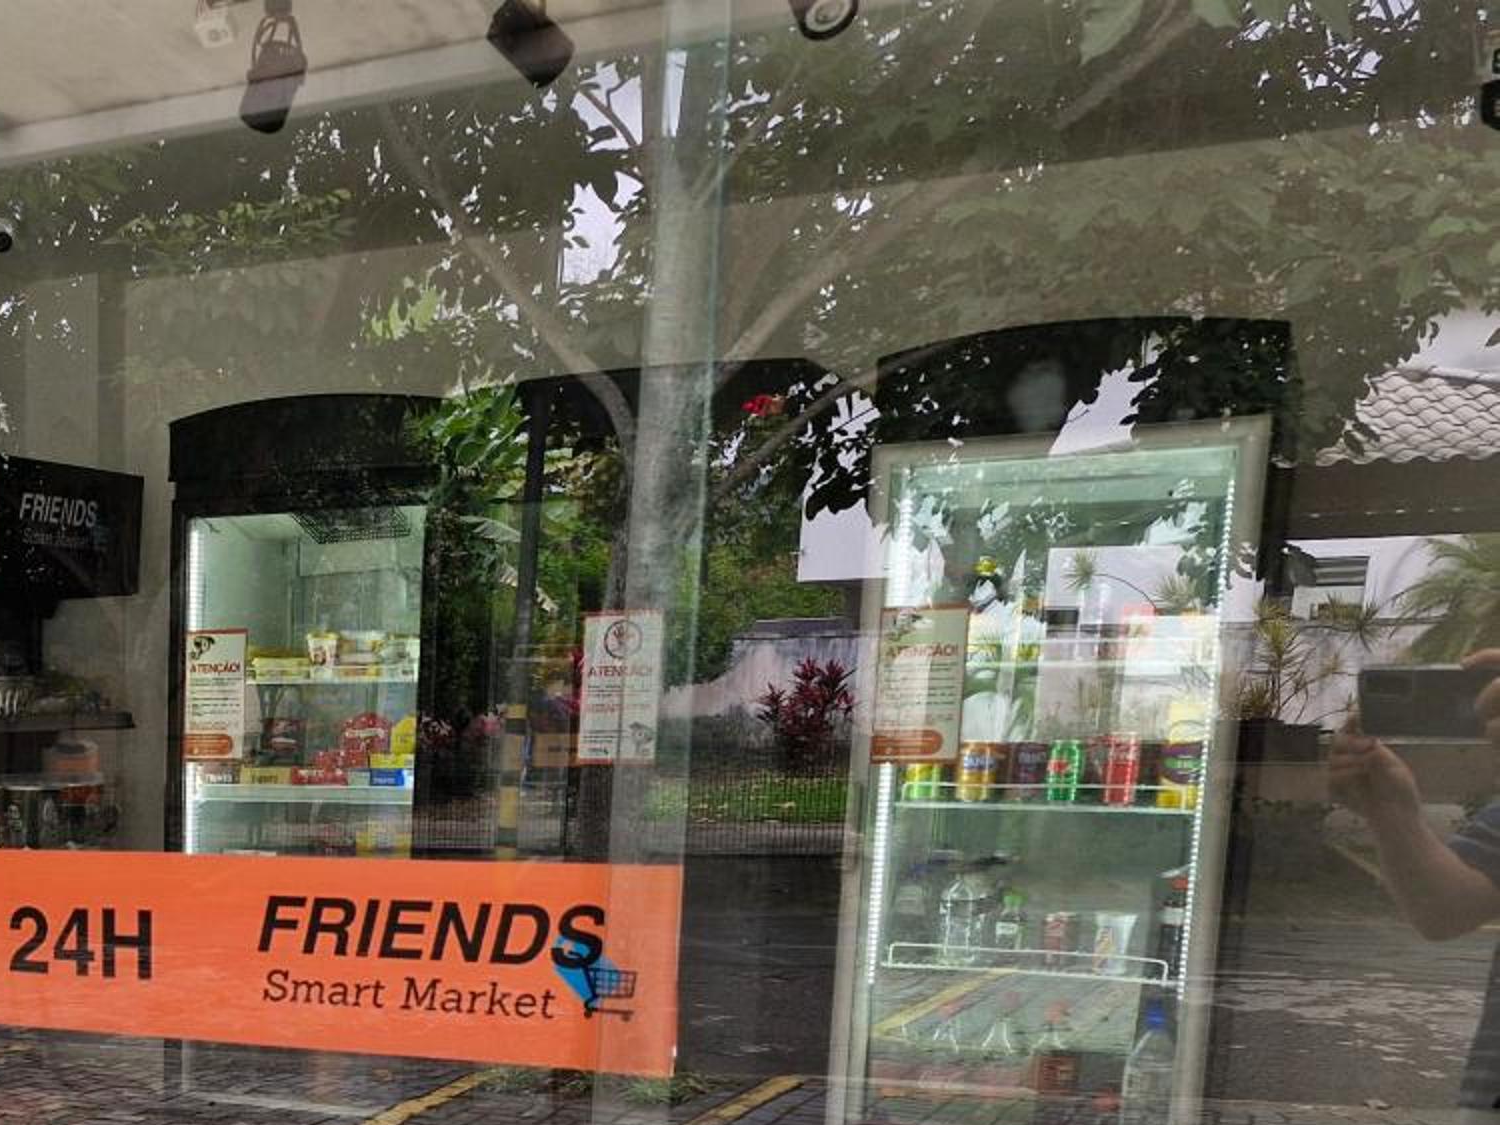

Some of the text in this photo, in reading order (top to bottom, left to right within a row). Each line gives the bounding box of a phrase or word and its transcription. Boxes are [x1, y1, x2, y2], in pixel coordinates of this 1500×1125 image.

[19, 491, 99, 528] FRIENDS
[8, 905, 154, 980] 24H
[257, 895, 607, 970] FRIENDS
[262, 969, 558, 1020] Smart Market
